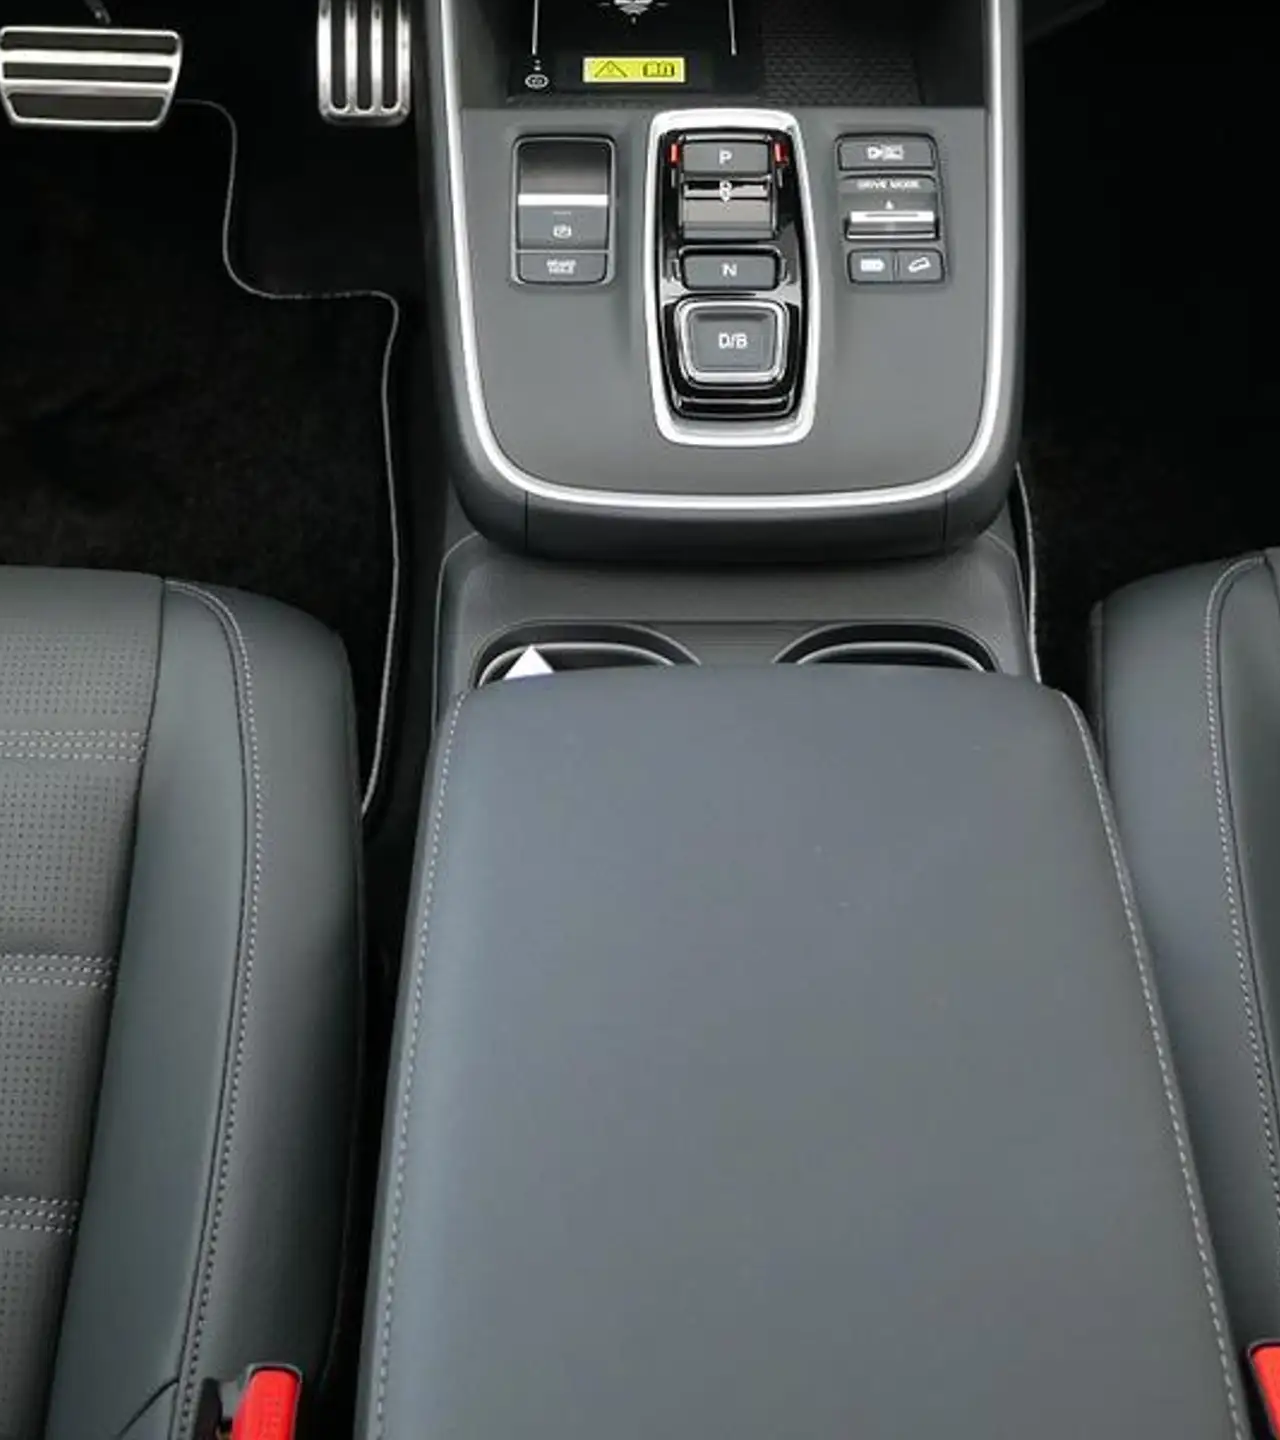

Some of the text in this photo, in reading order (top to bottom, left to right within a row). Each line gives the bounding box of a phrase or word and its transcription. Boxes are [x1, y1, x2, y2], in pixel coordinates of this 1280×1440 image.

[719, 150, 733, 165] P
[721, 262, 738, 277] N
[718, 332, 748, 349] D/B
